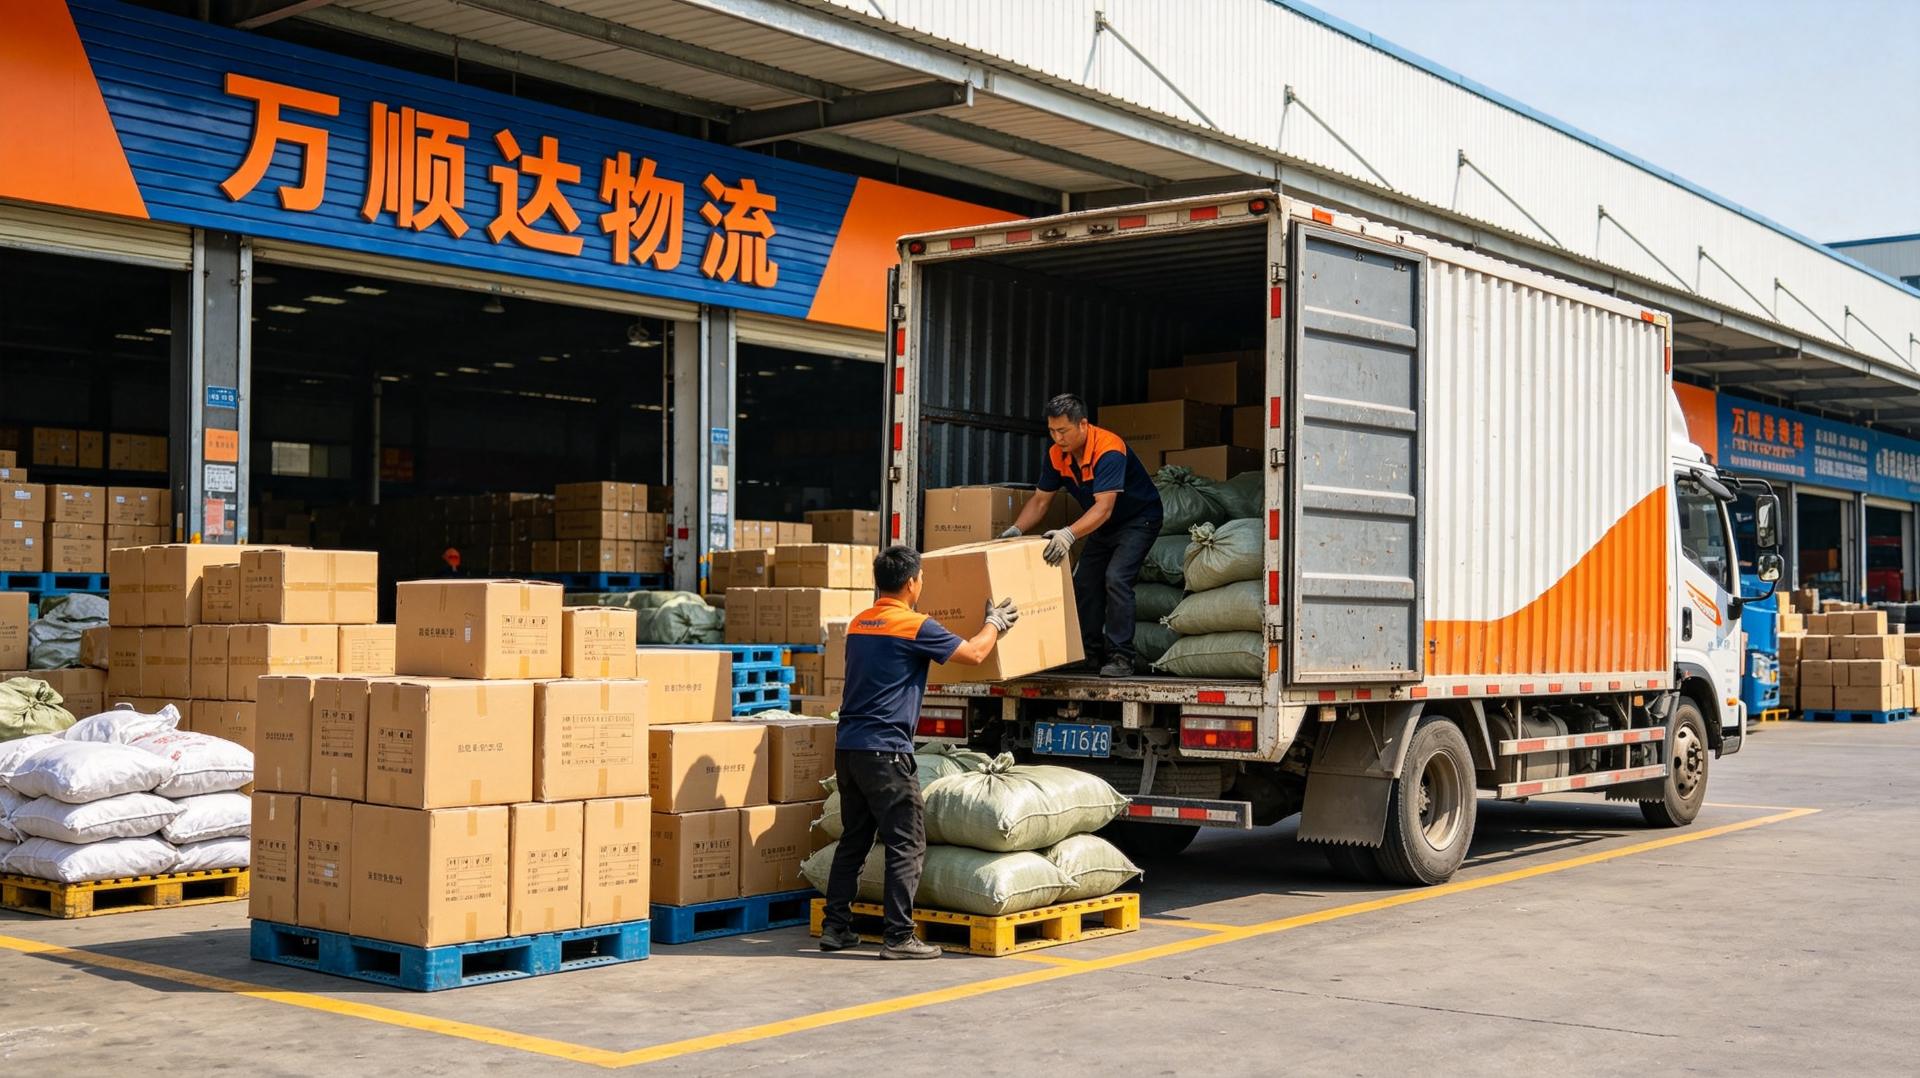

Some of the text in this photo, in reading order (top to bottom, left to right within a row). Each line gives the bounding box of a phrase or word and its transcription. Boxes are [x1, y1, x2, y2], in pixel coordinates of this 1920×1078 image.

[220, 72, 778, 288] 万顺达物流
